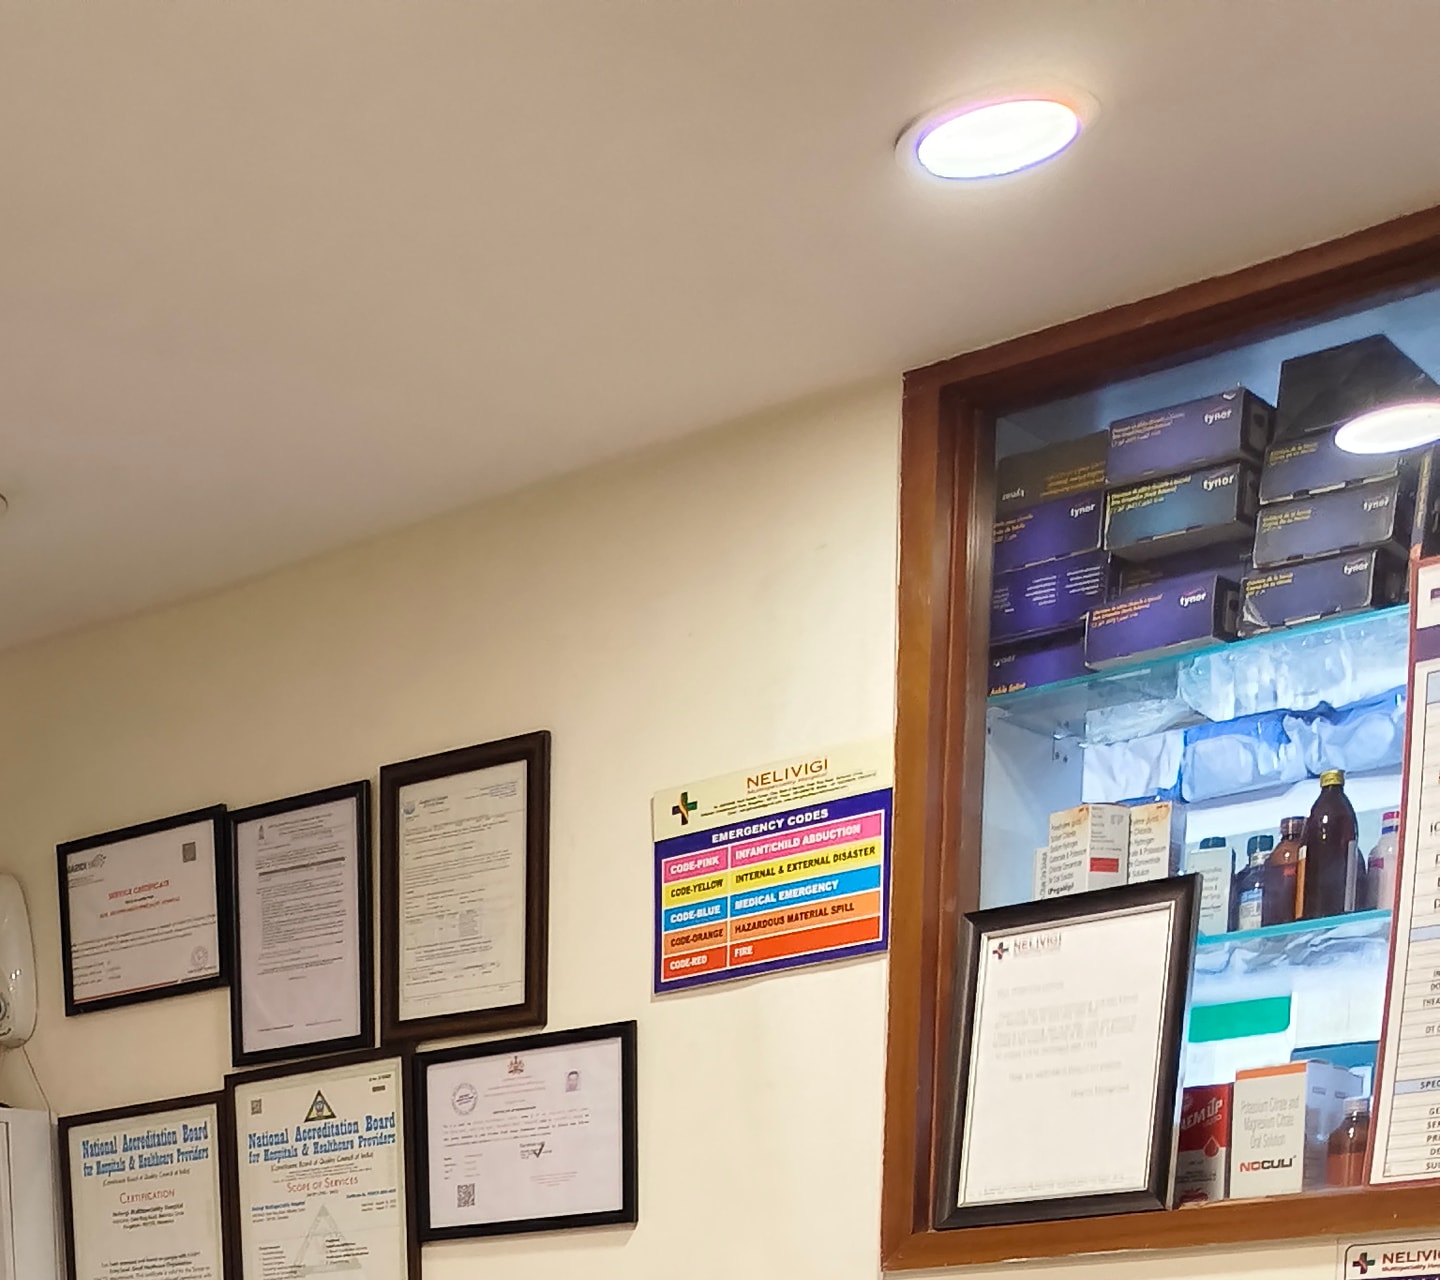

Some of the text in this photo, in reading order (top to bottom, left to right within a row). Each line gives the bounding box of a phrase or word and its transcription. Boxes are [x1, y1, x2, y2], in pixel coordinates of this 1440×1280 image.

[1204, 410, 1231, 424] tynor
[1203, 475, 1234, 491] tynor
[1070, 503, 1095, 519] tynor
[1344, 562, 1369, 575] tynor
[1180, 592, 1206, 607] tynor
[747, 759, 828, 789] NELIVIGI
[711, 808, 828, 843] EMERGENCY CODES
[670, 856, 720, 875] CODE-PINK
[802, 823, 861, 845] ABDUCTION
[671, 846, 875, 898] CODE-YELLOW INTERNAL & EXTERNAL DISASTER
[670, 880, 839, 924] CODE-BLUE MEDICAL EMERGENCY
[671, 902, 855, 947] CODE-ORANGE HAZARDOUS MATERIAL SPILL
[669, 946, 753, 970] CODE-RED FIRE
[82, 1121, 208, 1159] National Accreditation Board
[248, 1112, 395, 1149] National Accreditation Board
[83, 1146, 209, 1177] for Hospitals & Healthcare Providers
[249, 1132, 395, 1164] for Hospitals & Healthcare Providers
[1240, 1159, 1294, 1173] NOCULI
[1382, 1250, 1440, 1264] NELIVI
